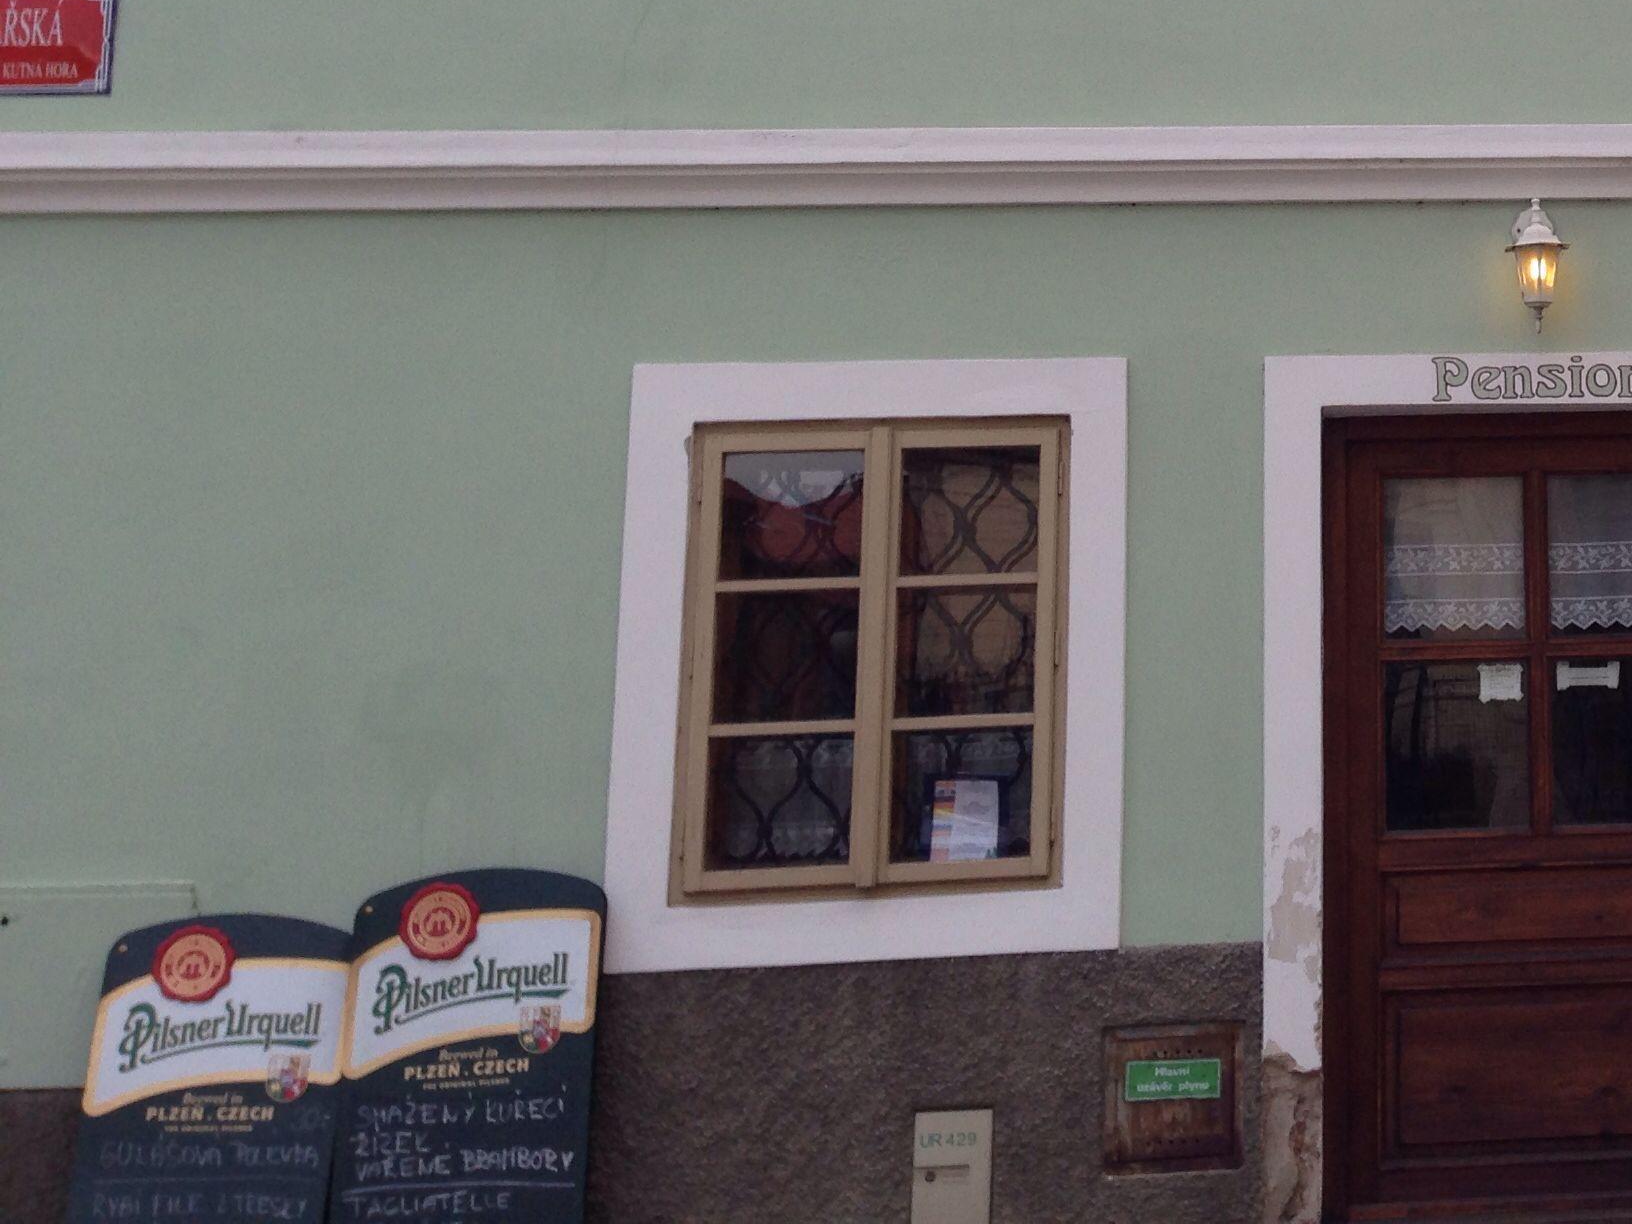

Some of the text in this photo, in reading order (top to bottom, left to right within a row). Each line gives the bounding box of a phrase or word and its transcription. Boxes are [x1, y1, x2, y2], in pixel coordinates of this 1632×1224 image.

[45, 62, 79, 78] HORA
[372, 951, 568, 1036] Pilsner Urquell
[118, 998, 323, 1074] Pilsner Urquell
[473, 1057, 529, 1076] CZECH
